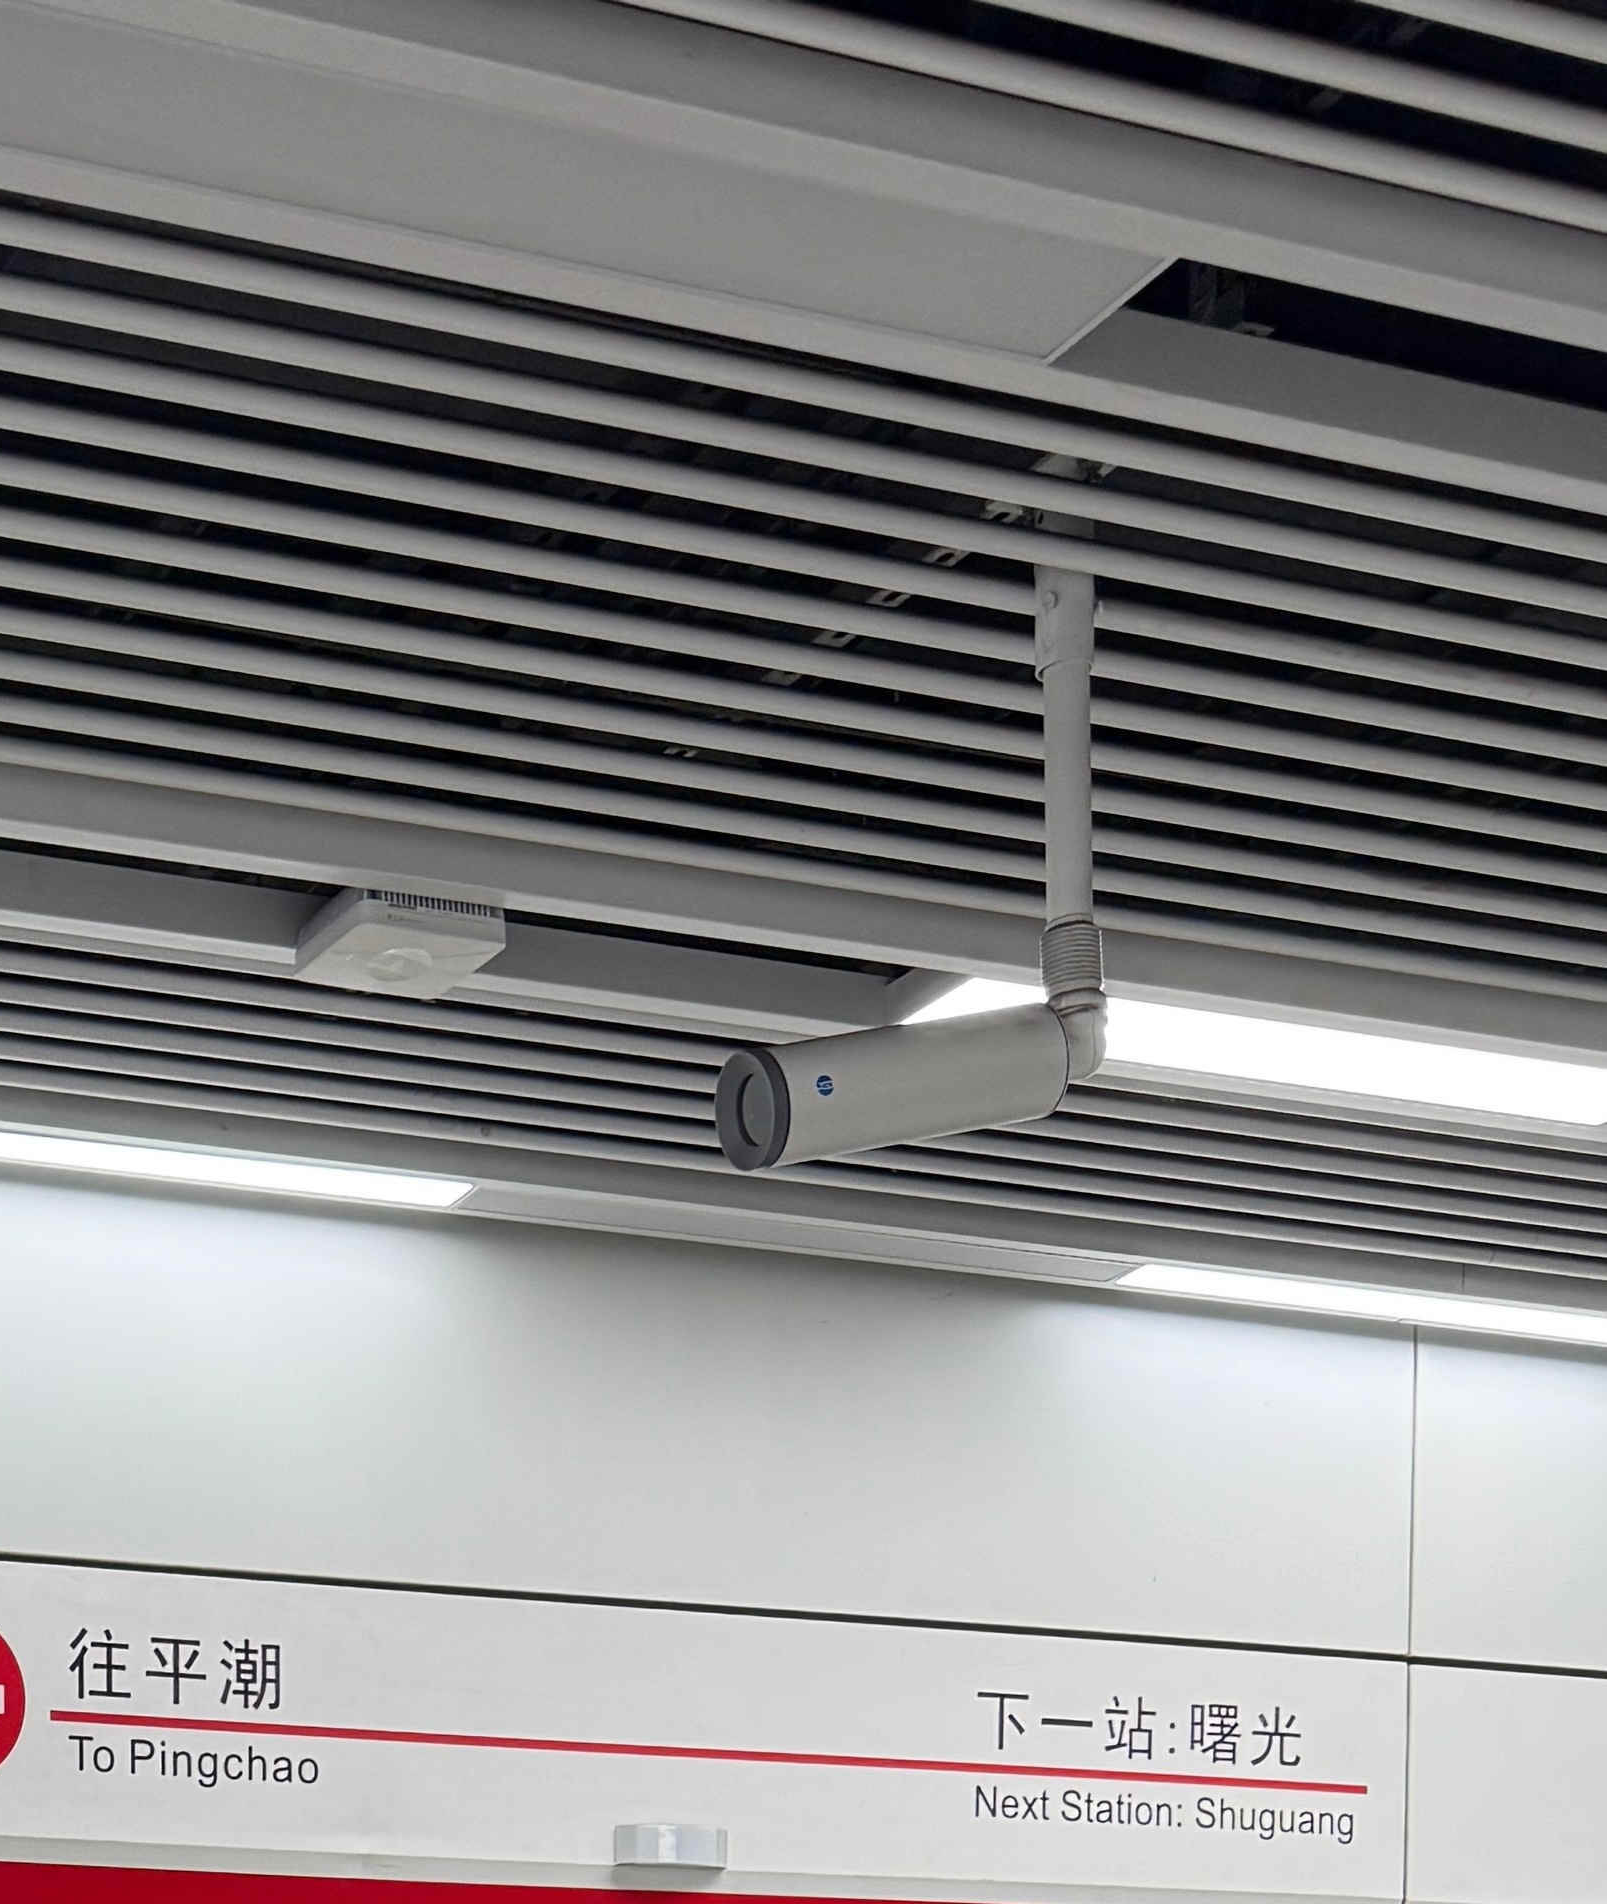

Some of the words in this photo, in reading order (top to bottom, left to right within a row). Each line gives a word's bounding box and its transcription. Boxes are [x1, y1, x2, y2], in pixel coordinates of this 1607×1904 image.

[68, 1627, 281, 1711] 往平潮
[68, 1734, 115, 1773] To
[129, 1738, 320, 1788] Pingchao
[974, 1785, 1050, 1822] Next
[1061, 1791, 1183, 1828] Station:
[1195, 1797, 1356, 1845] Shuguang
